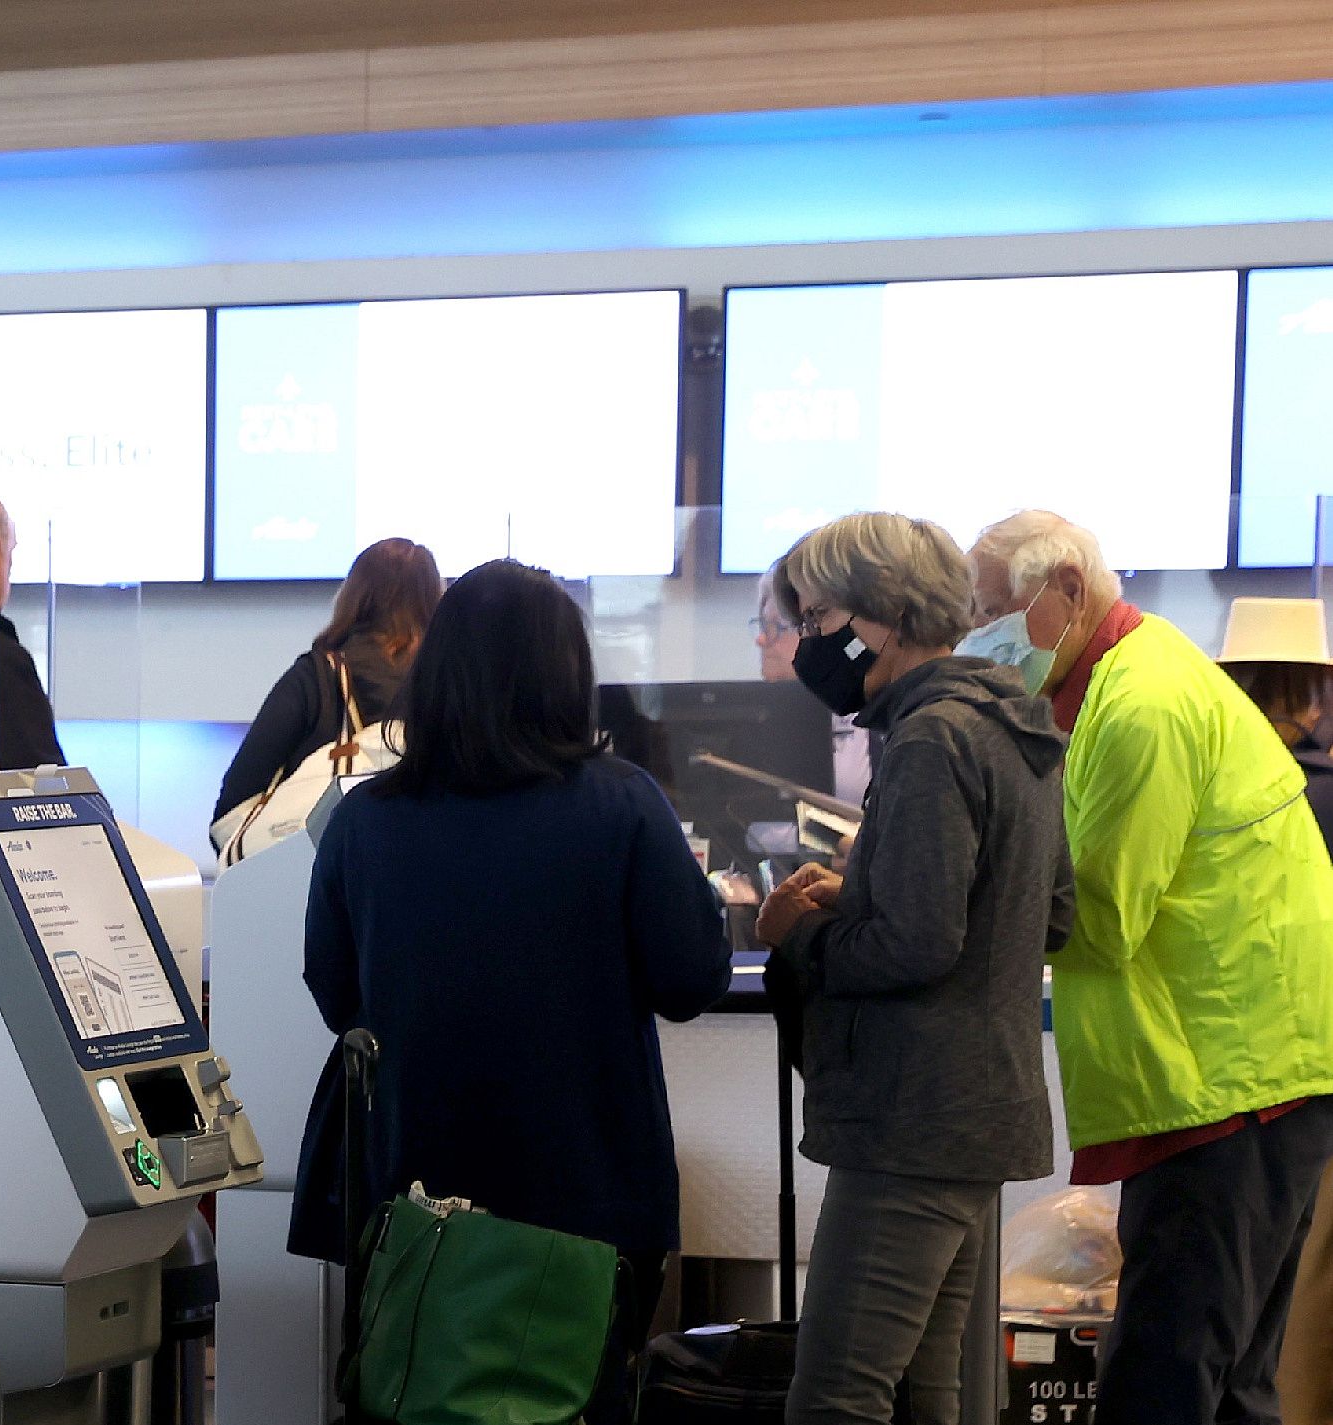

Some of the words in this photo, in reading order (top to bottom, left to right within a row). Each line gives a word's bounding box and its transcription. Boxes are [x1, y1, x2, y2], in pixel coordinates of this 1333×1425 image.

[66, 434, 153, 467] Elite
[12, 804, 41, 823] RAISE
[37, 803, 59, 821] THE
[1029, 1380, 1067, 1399] 100
